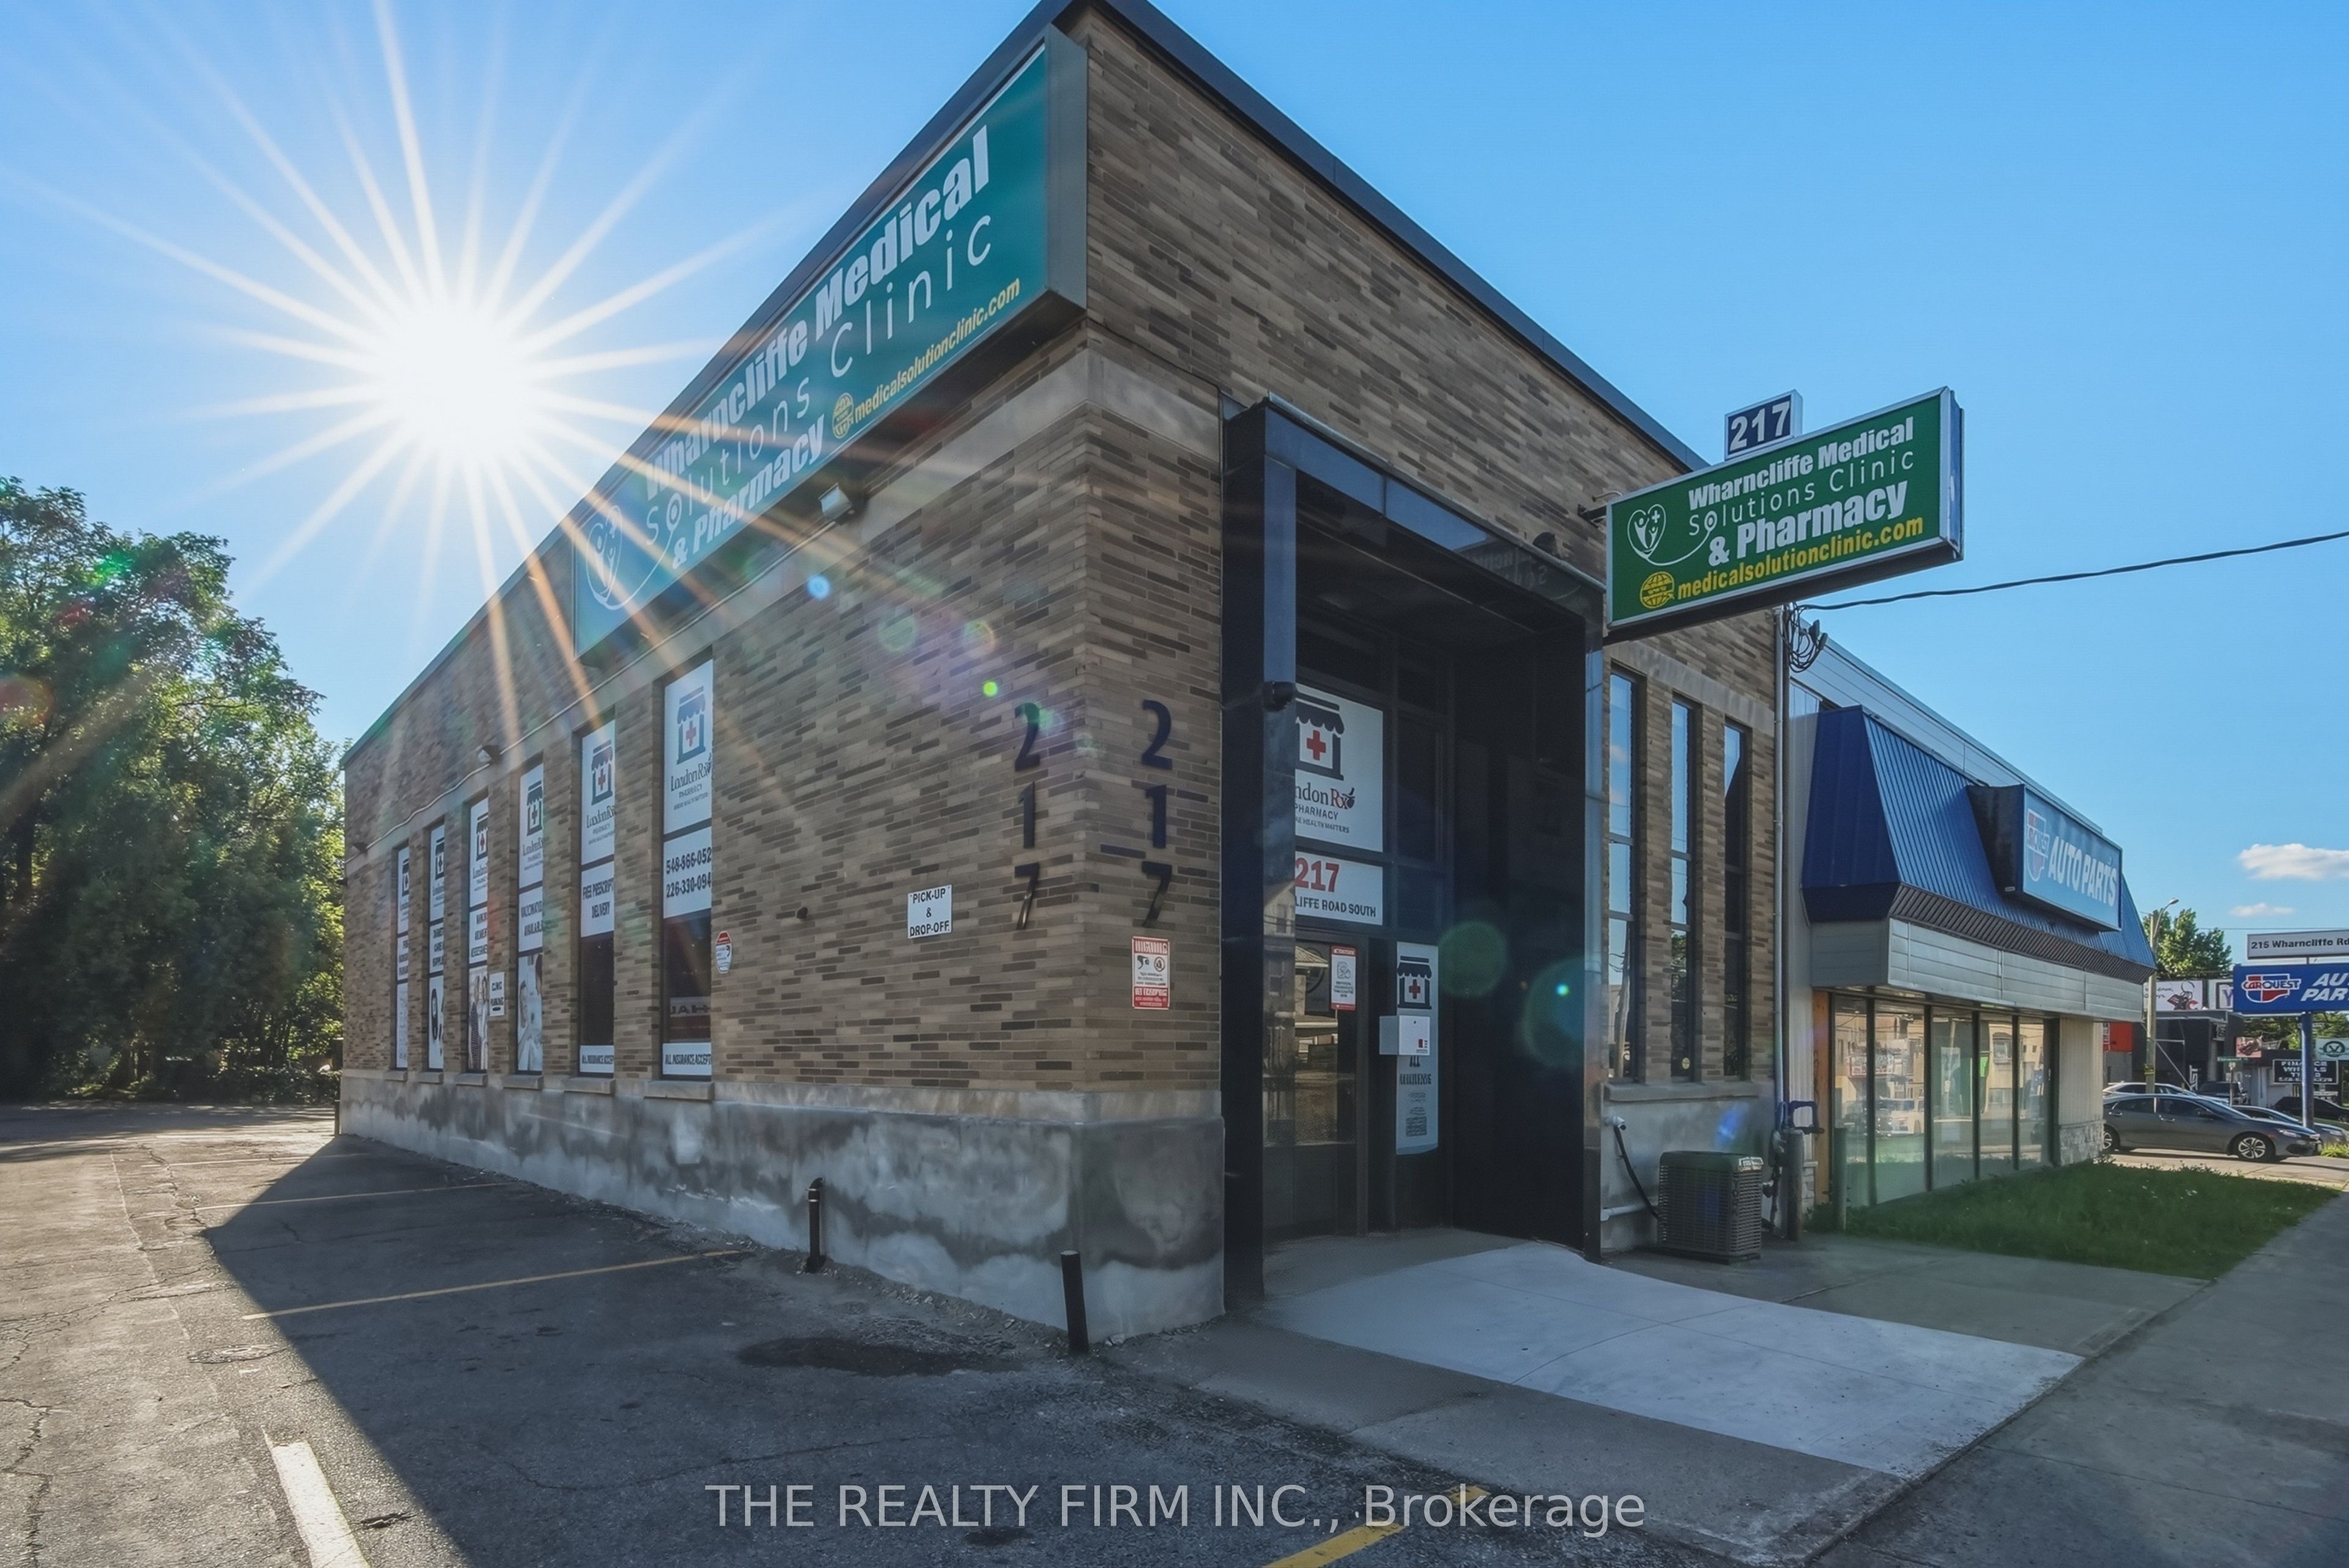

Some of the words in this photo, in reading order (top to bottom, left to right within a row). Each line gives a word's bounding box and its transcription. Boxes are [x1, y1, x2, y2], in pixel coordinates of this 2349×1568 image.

[646, 319, 807, 500] Wharncliffe
[815, 126, 990, 341] Medical
[855, 276, 1021, 423] medicalsolutionclinic.com
[646, 377, 810, 545] Solutions
[831, 215, 992, 378] Clinic
[1729, 401, 1791, 452] 217
[1688, 454, 1814, 511] Wharncliffe
[1818, 416, 1914, 470] Medical
[673, 537, 688, 569] &
[692, 413, 825, 555] Pharmacy
[1688, 483, 1816, 536] Solutions
[1830, 449, 1914, 492] Clinic
[1708, 536, 1730, 567] &
[1737, 480, 1908, 560] Pharmacy
[1677, 517, 1924, 599] medicalsolutionclinic.com
[913, 888, 946, 904] PICK-UP
[1294, 857, 1340, 892] 217
[2048, 836, 2082, 892] AUTO
[2082, 854, 2117, 907] PARTS
[910, 920, 949, 937] DROP-OFF
[926, 907, 932, 918] &
[1322, 900, 1347, 912] ROAD
[1348, 904, 1376, 917] SOUTH
[2251, 941, 2269, 949] 215
[2243, 980, 2300, 989] CARQUEST
[2300, 987, 2349, 1002] PAR
[2311, 972, 2349, 987] AU
